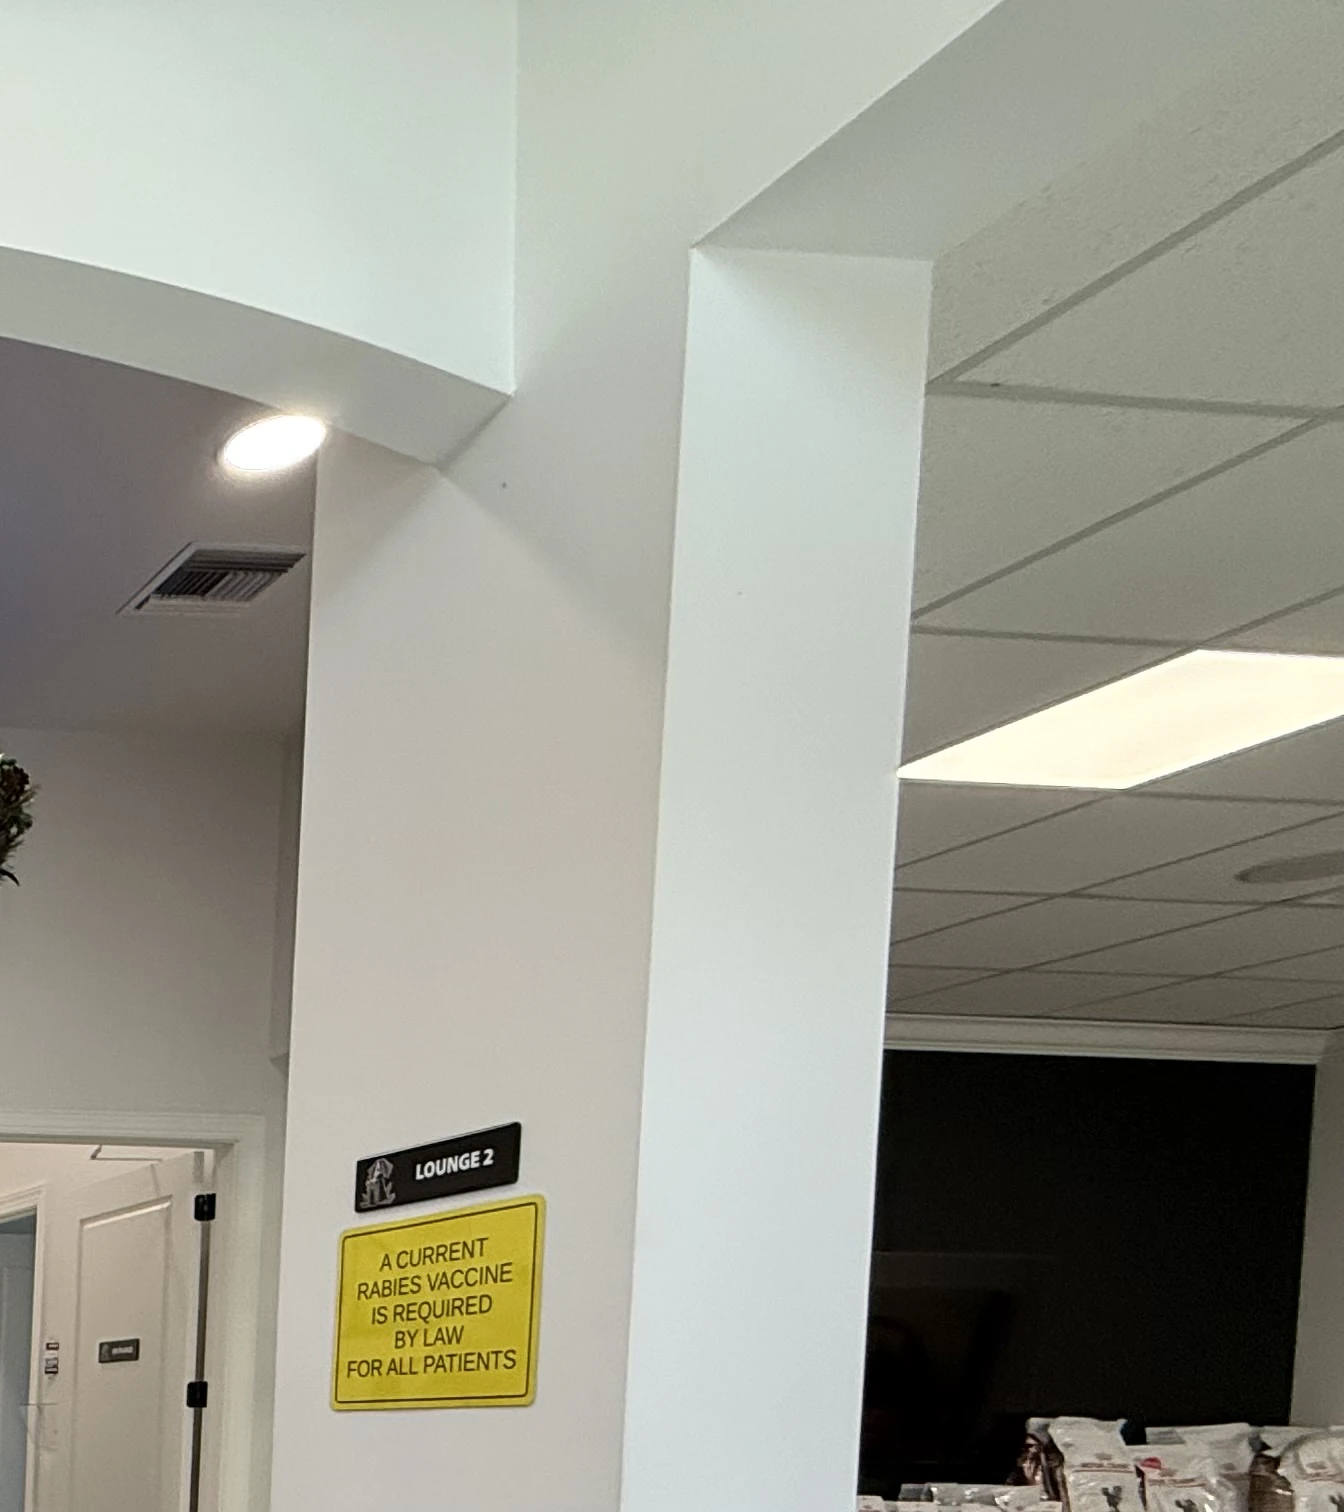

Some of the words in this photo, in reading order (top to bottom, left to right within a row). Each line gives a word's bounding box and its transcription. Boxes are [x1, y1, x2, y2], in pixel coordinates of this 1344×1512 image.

[415, 1150, 480, 1181] LOUNGE
[483, 1148, 494, 1165] 2
[379, 1253, 392, 1273] A
[396, 1237, 489, 1270] CURRENT
[357, 1275, 422, 1301] RABIES
[427, 1262, 513, 1292] VACCINE
[371, 1307, 388, 1325] IS
[393, 1294, 492, 1324] REQUIRED
[394, 1329, 418, 1349] BY
[423, 1325, 464, 1346] LAW
[347, 1359, 382, 1379] FOR
[386, 1357, 418, 1376] ALL
[423, 1349, 517, 1374] PATIENTS
